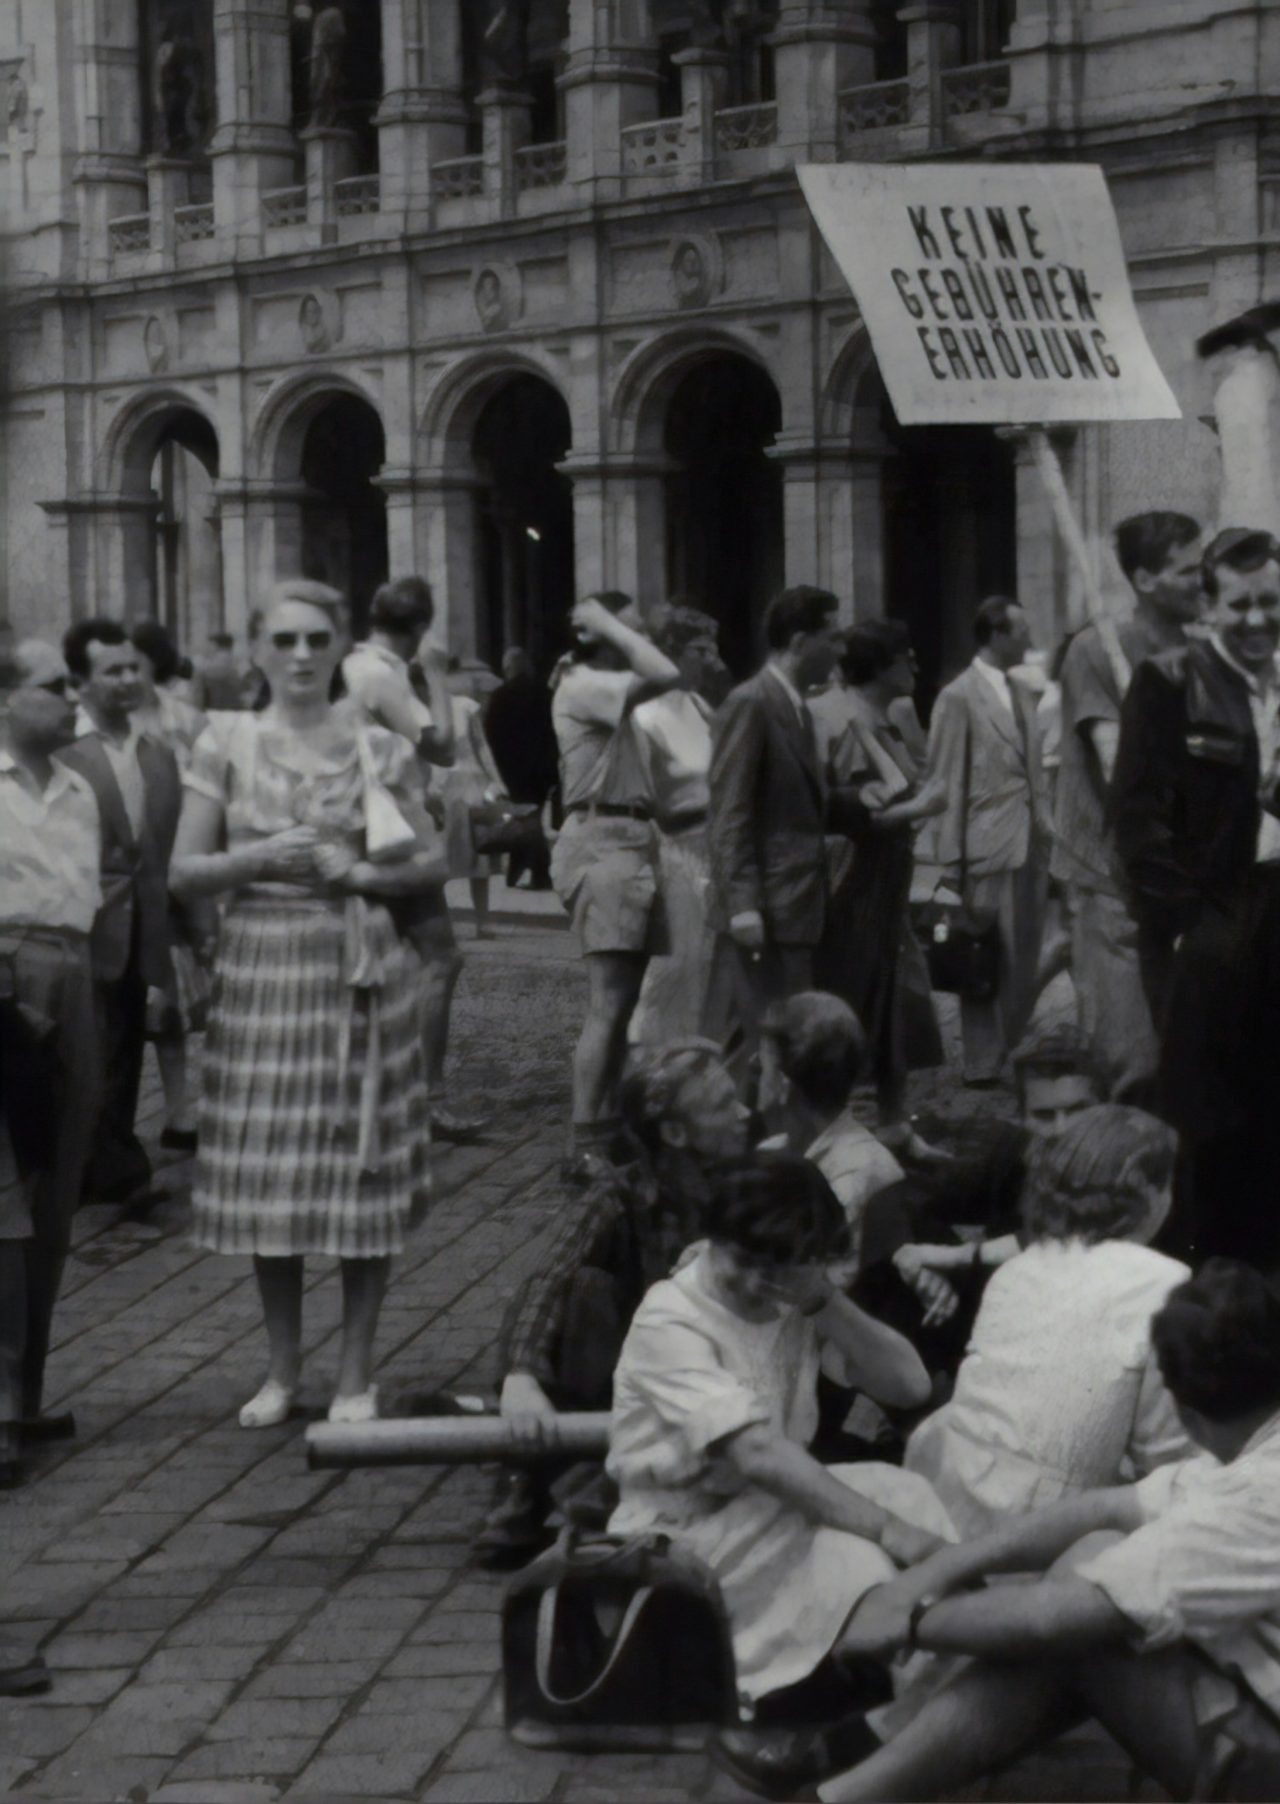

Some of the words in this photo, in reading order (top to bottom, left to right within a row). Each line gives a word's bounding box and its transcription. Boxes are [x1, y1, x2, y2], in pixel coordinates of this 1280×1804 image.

[906, 204, 1045, 260] KEINE
[890, 261, 1103, 322] GEBÜHREN-
[916, 321, 1121, 380] ERHÖHUNG
